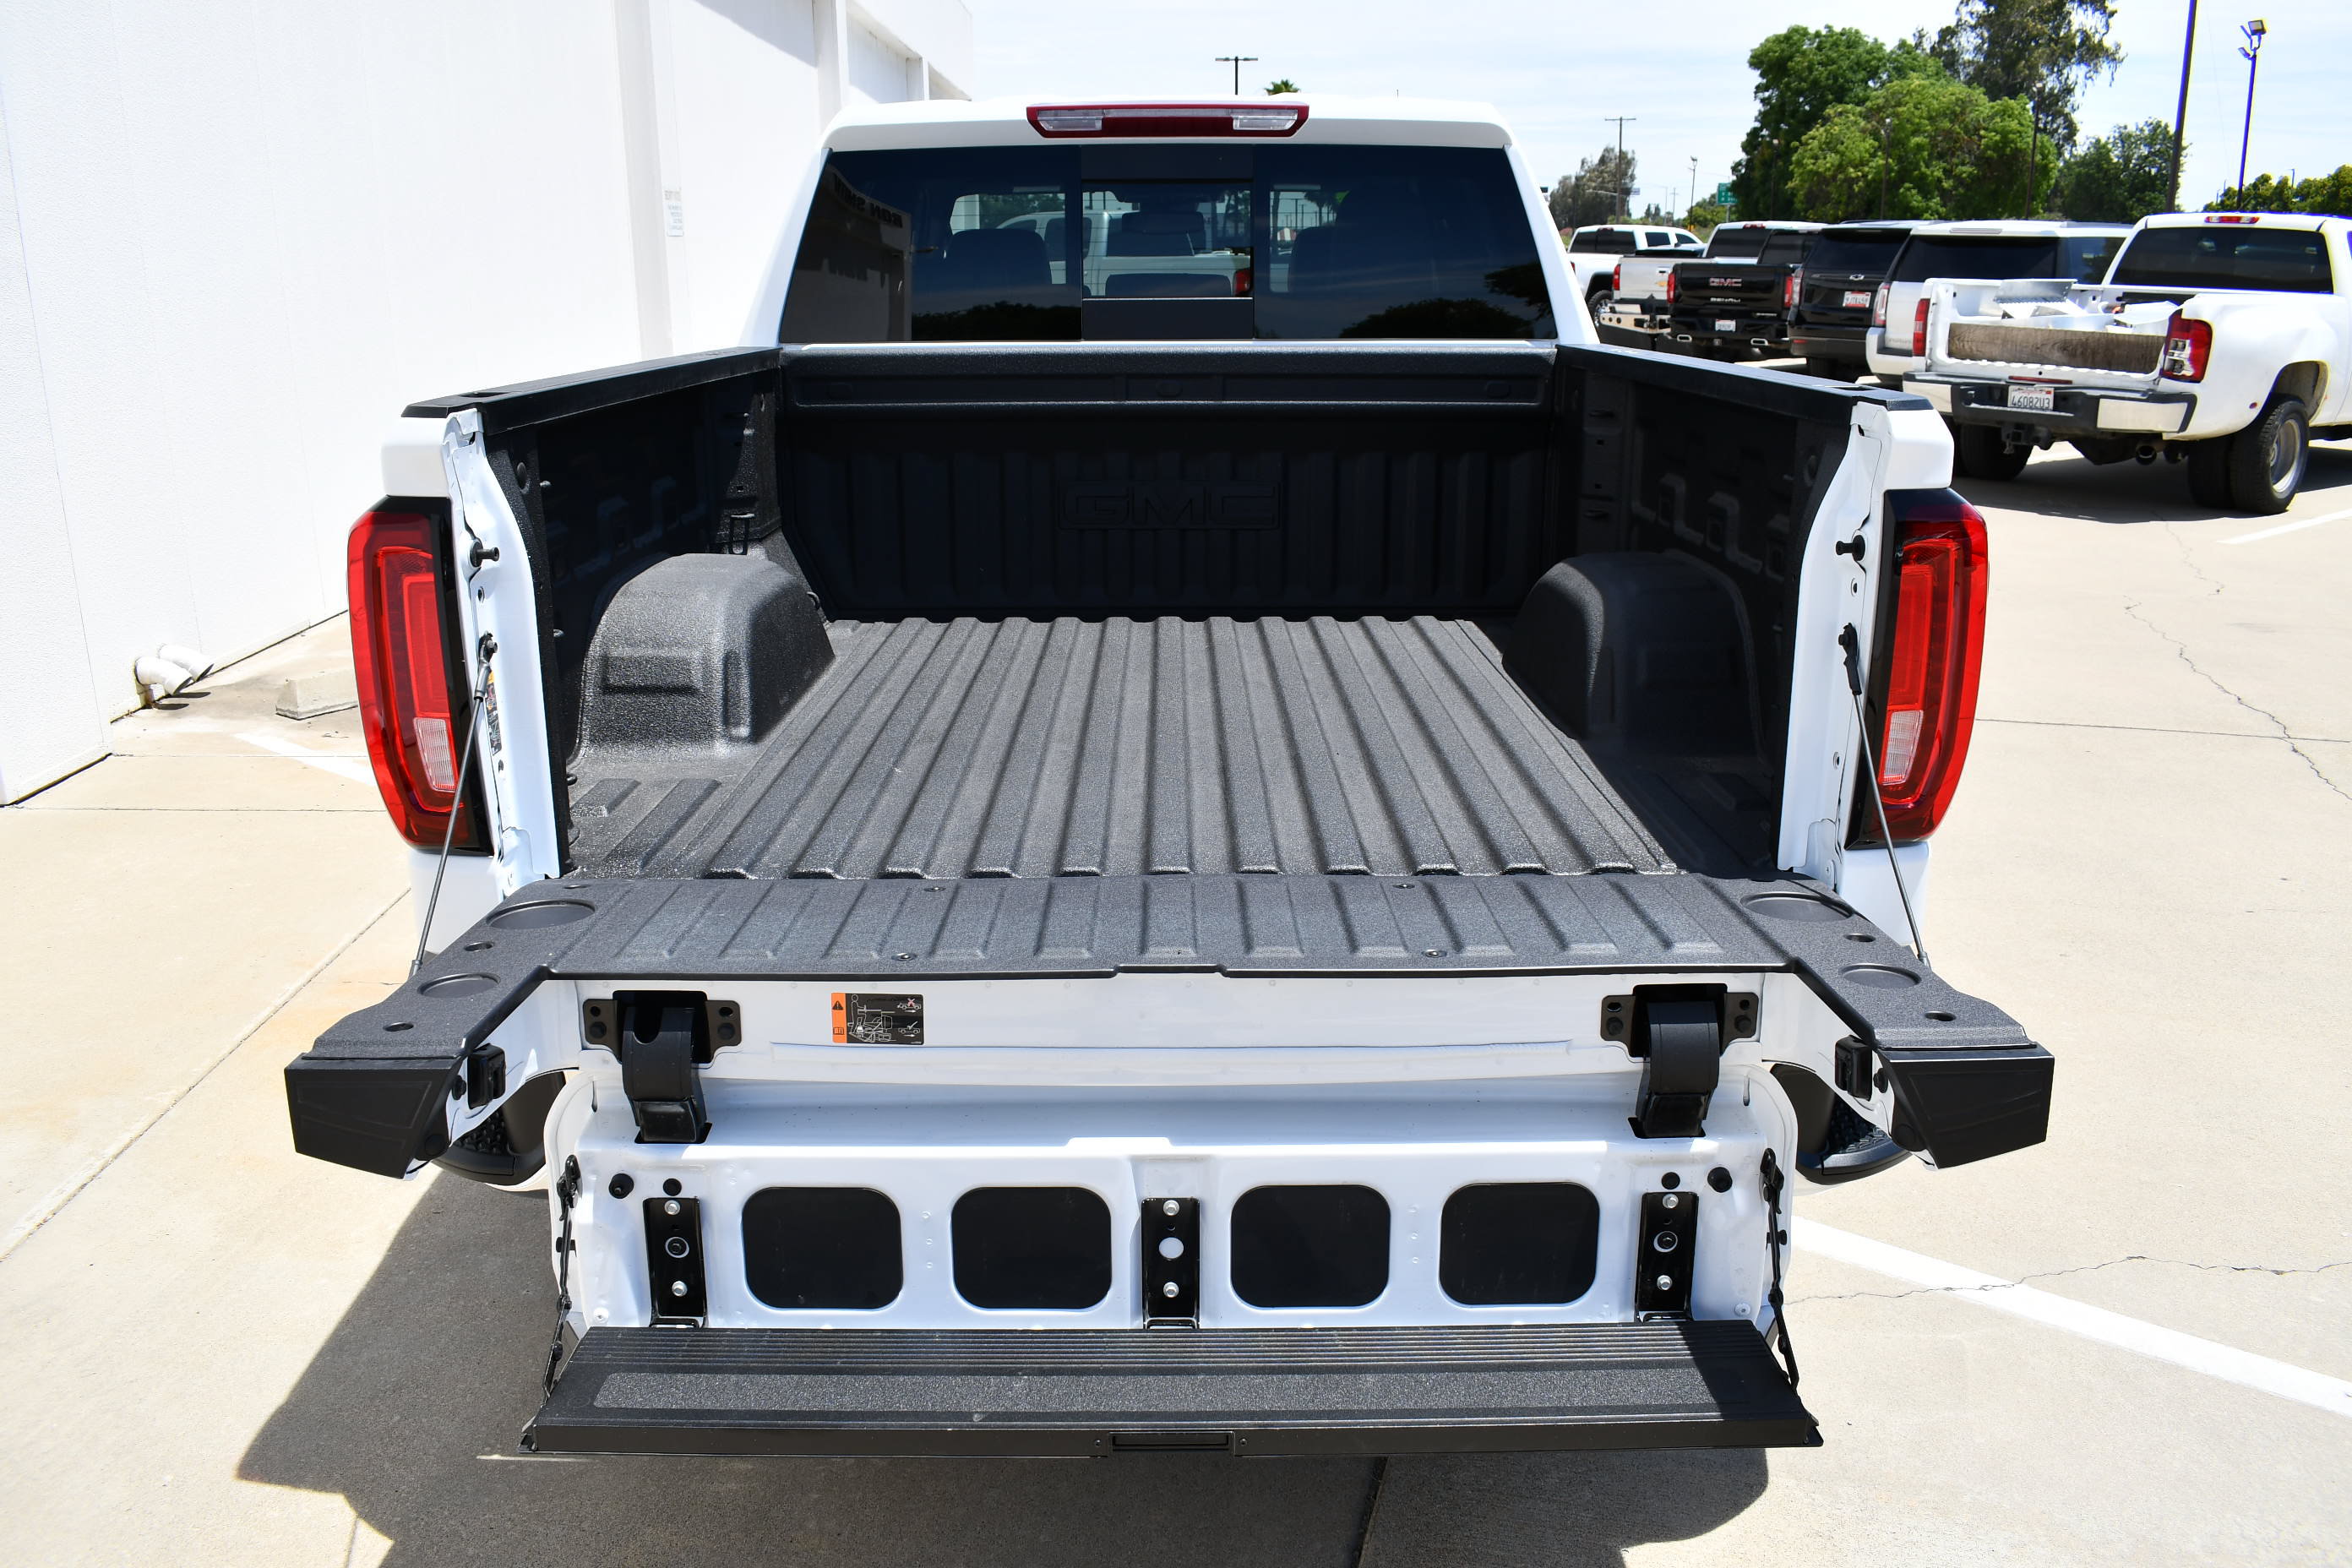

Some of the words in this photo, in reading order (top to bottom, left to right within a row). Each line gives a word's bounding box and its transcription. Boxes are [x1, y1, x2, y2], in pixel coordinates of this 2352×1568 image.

[1709, 277, 1742, 287] GMC
[2012, 395, 2050, 408] 46082U3
[1062, 483, 1277, 525] GMC
